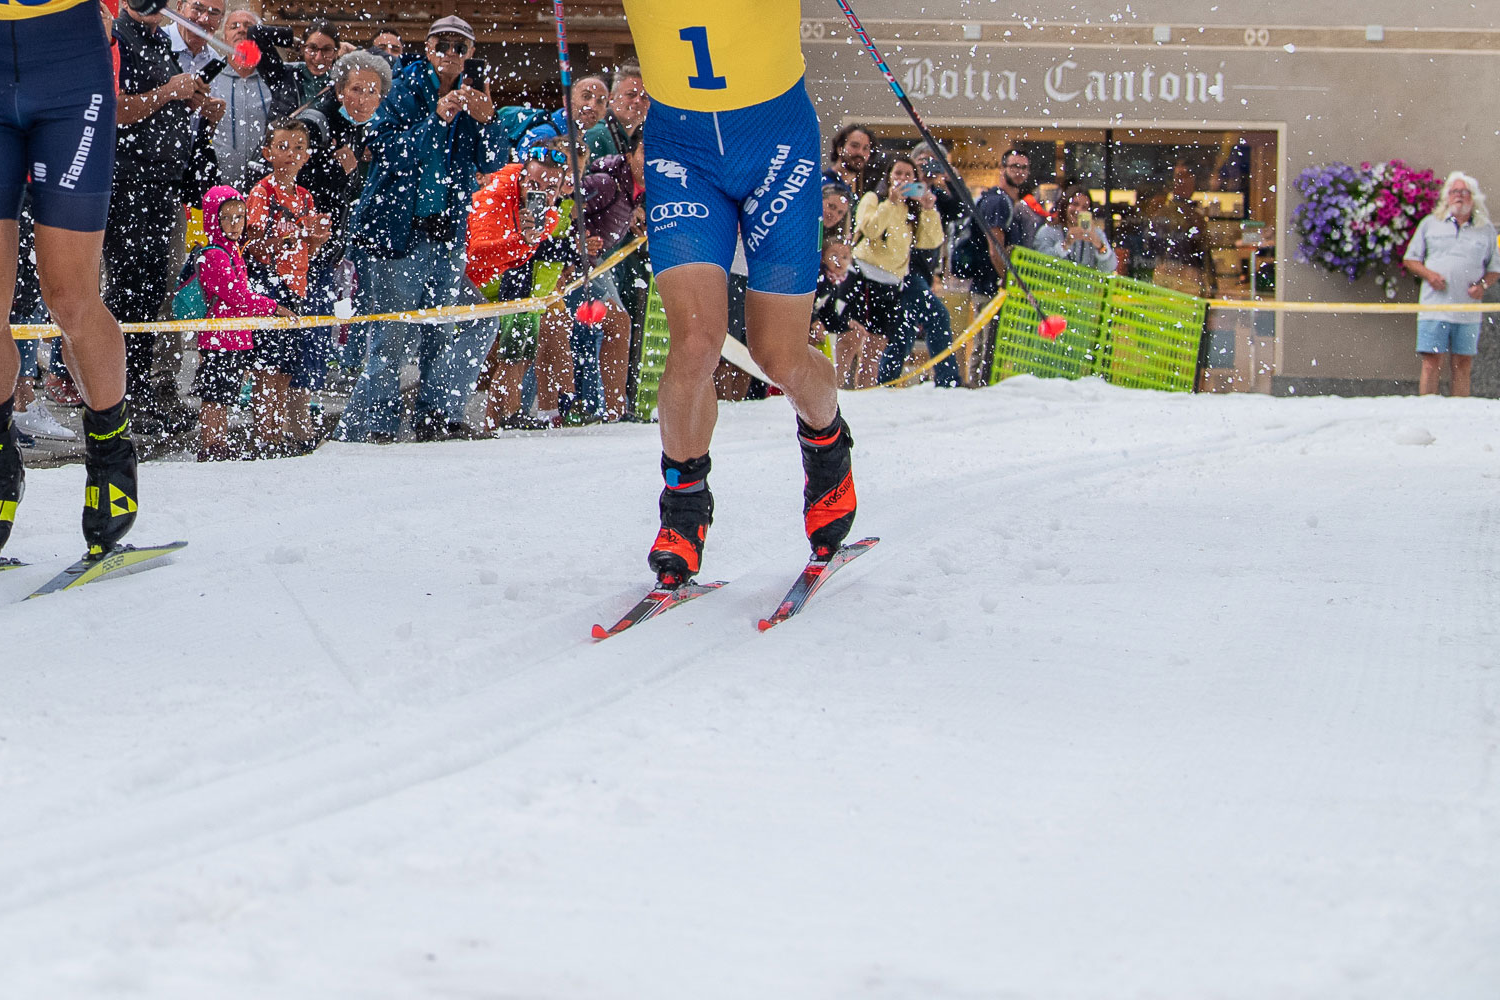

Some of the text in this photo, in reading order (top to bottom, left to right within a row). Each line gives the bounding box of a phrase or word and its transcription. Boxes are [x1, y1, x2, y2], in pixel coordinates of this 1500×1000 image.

[679, 26, 728, 91] 1
[1045, 60, 1227, 103] Cantoni
[58, 93, 104, 190] Fiamme Oro
[754, 144, 791, 198] sportful
[653, 220, 677, 233] Audi
[747, 158, 815, 252] FALCONERI
